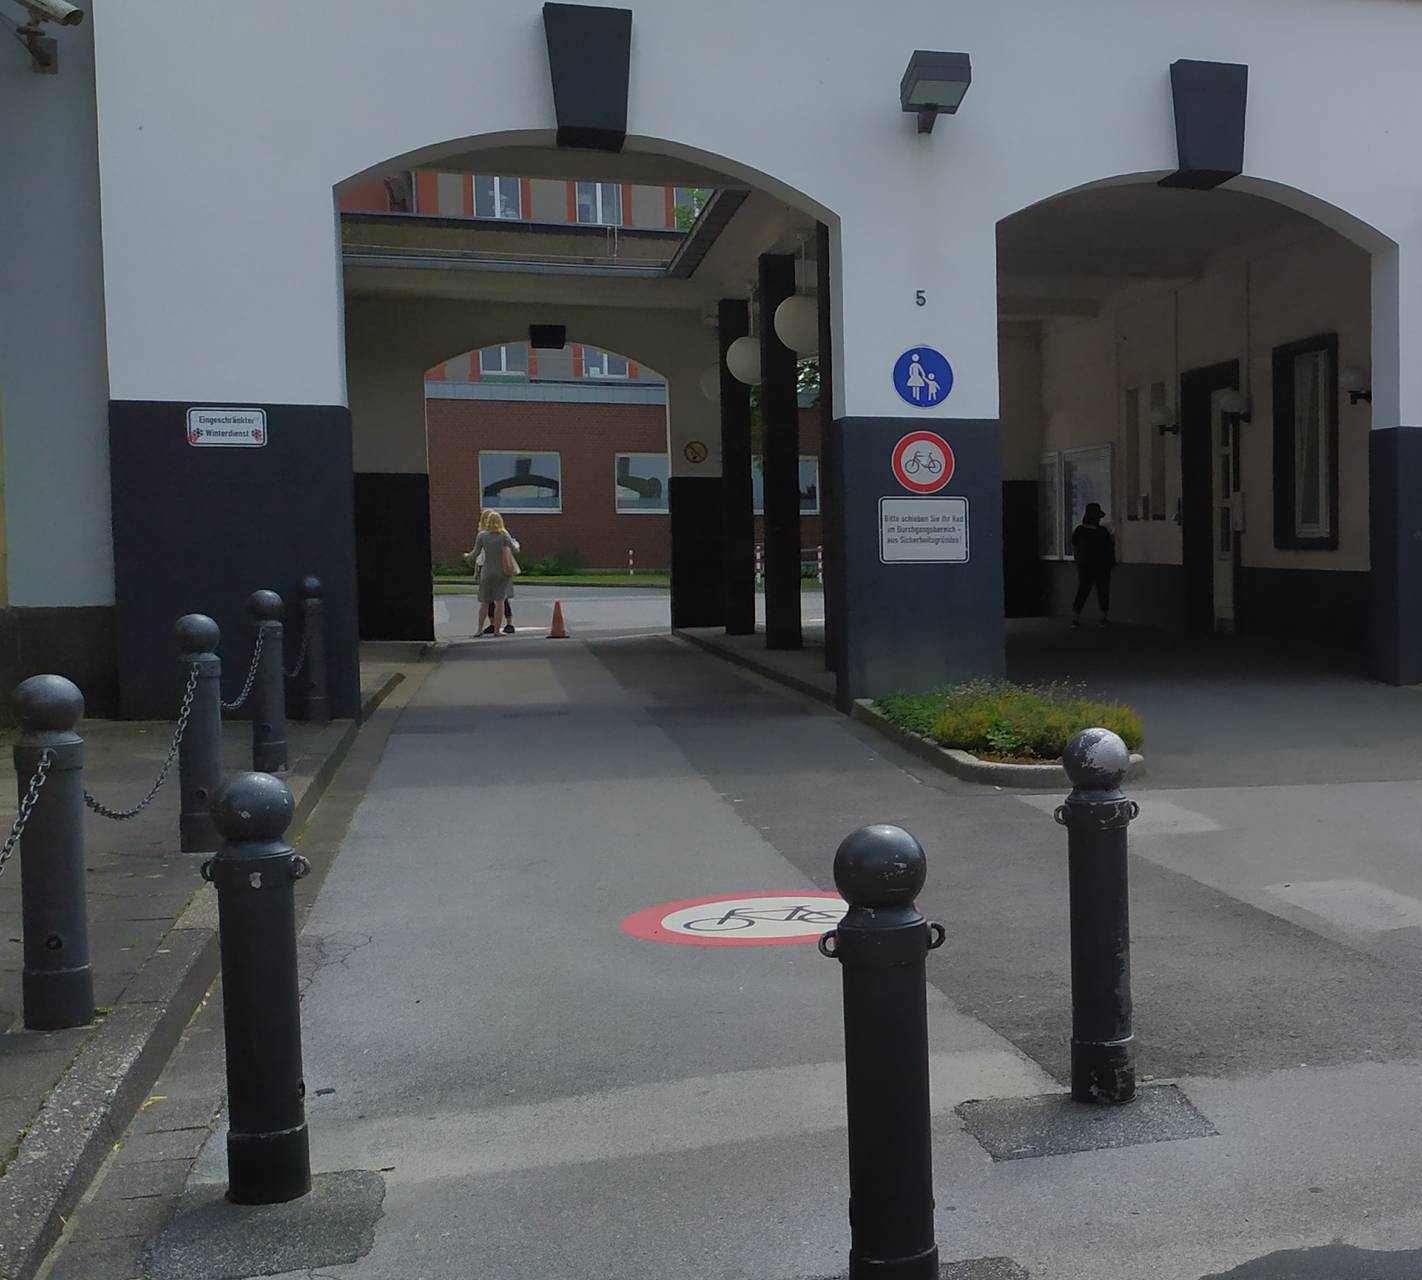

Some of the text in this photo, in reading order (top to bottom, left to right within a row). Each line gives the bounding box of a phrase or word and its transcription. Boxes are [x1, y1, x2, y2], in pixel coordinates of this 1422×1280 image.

[915, 290, 927, 307] 5
[199, 416, 255, 426] Eingeschränkter
[205, 429, 250, 438] Winterdienst
